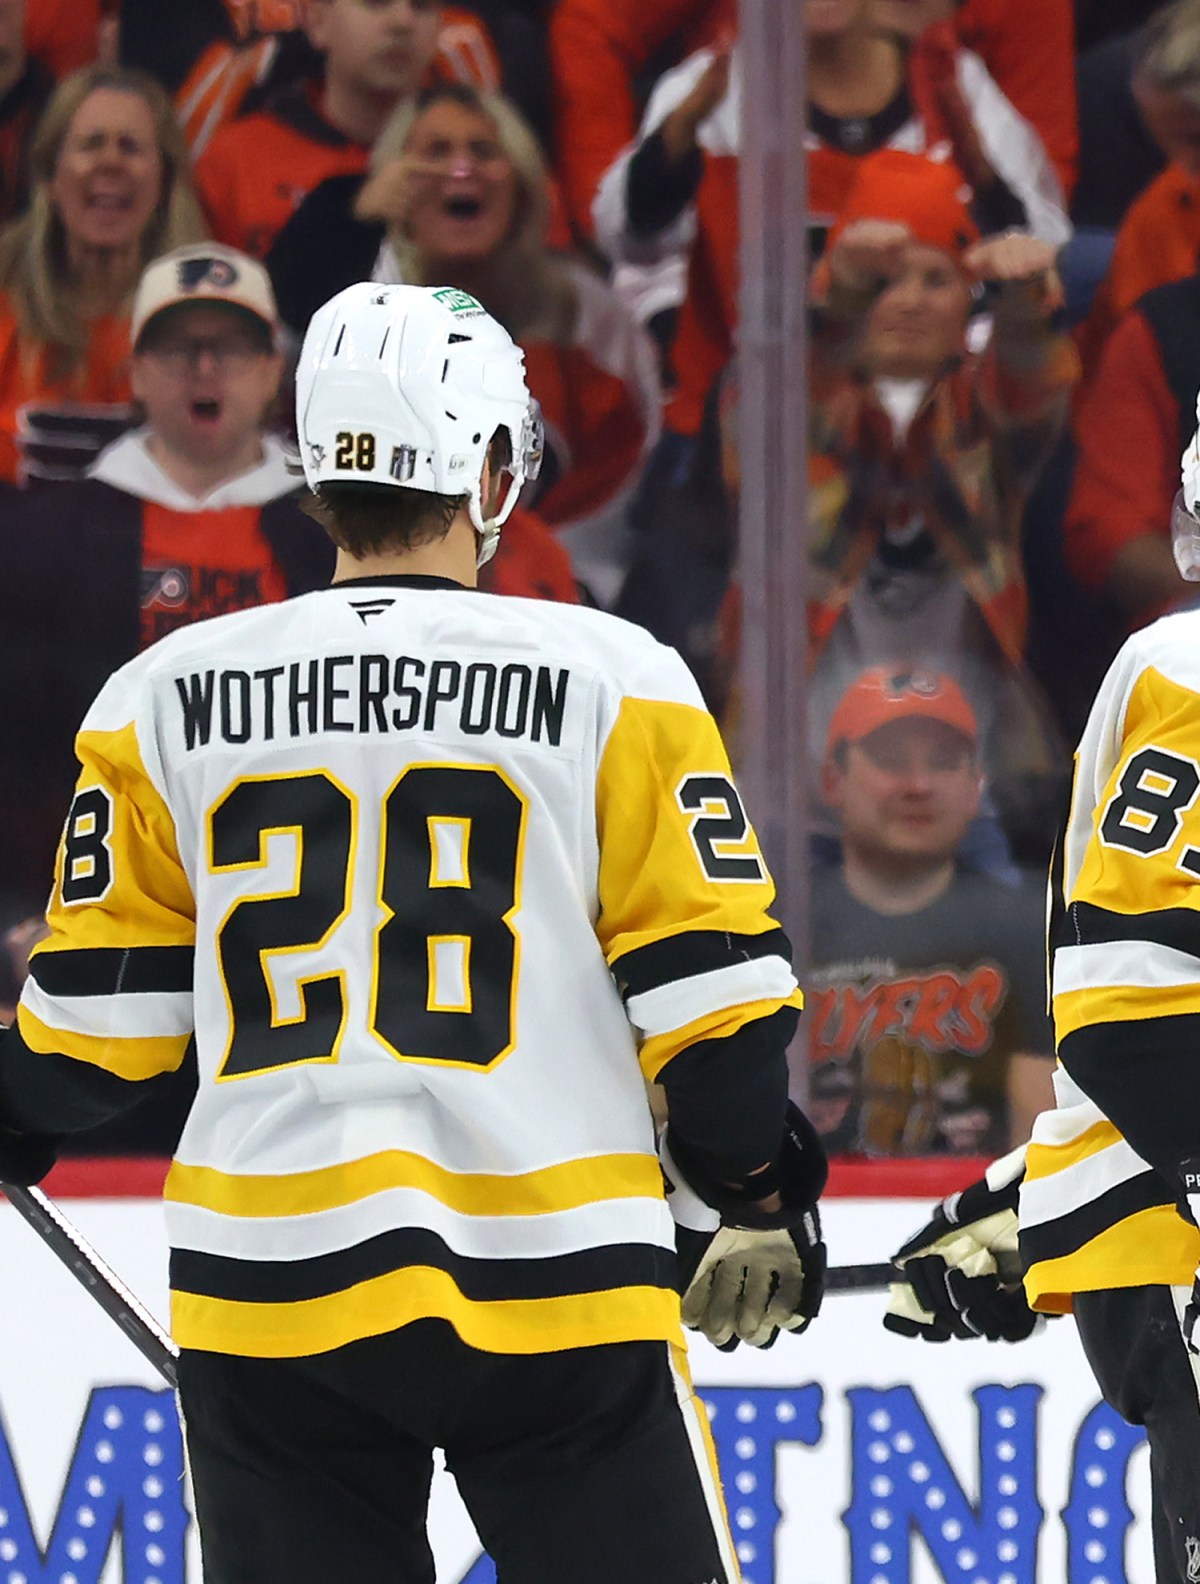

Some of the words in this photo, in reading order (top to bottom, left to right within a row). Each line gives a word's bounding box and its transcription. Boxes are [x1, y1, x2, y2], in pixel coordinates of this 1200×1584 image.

[335, 432, 376, 472] 28
[174, 654, 570, 752] WOTHERSPOON
[46, 783, 115, 909] 8
[204, 761, 532, 1085] 28
[808, 964, 1002, 1063] LYERS
